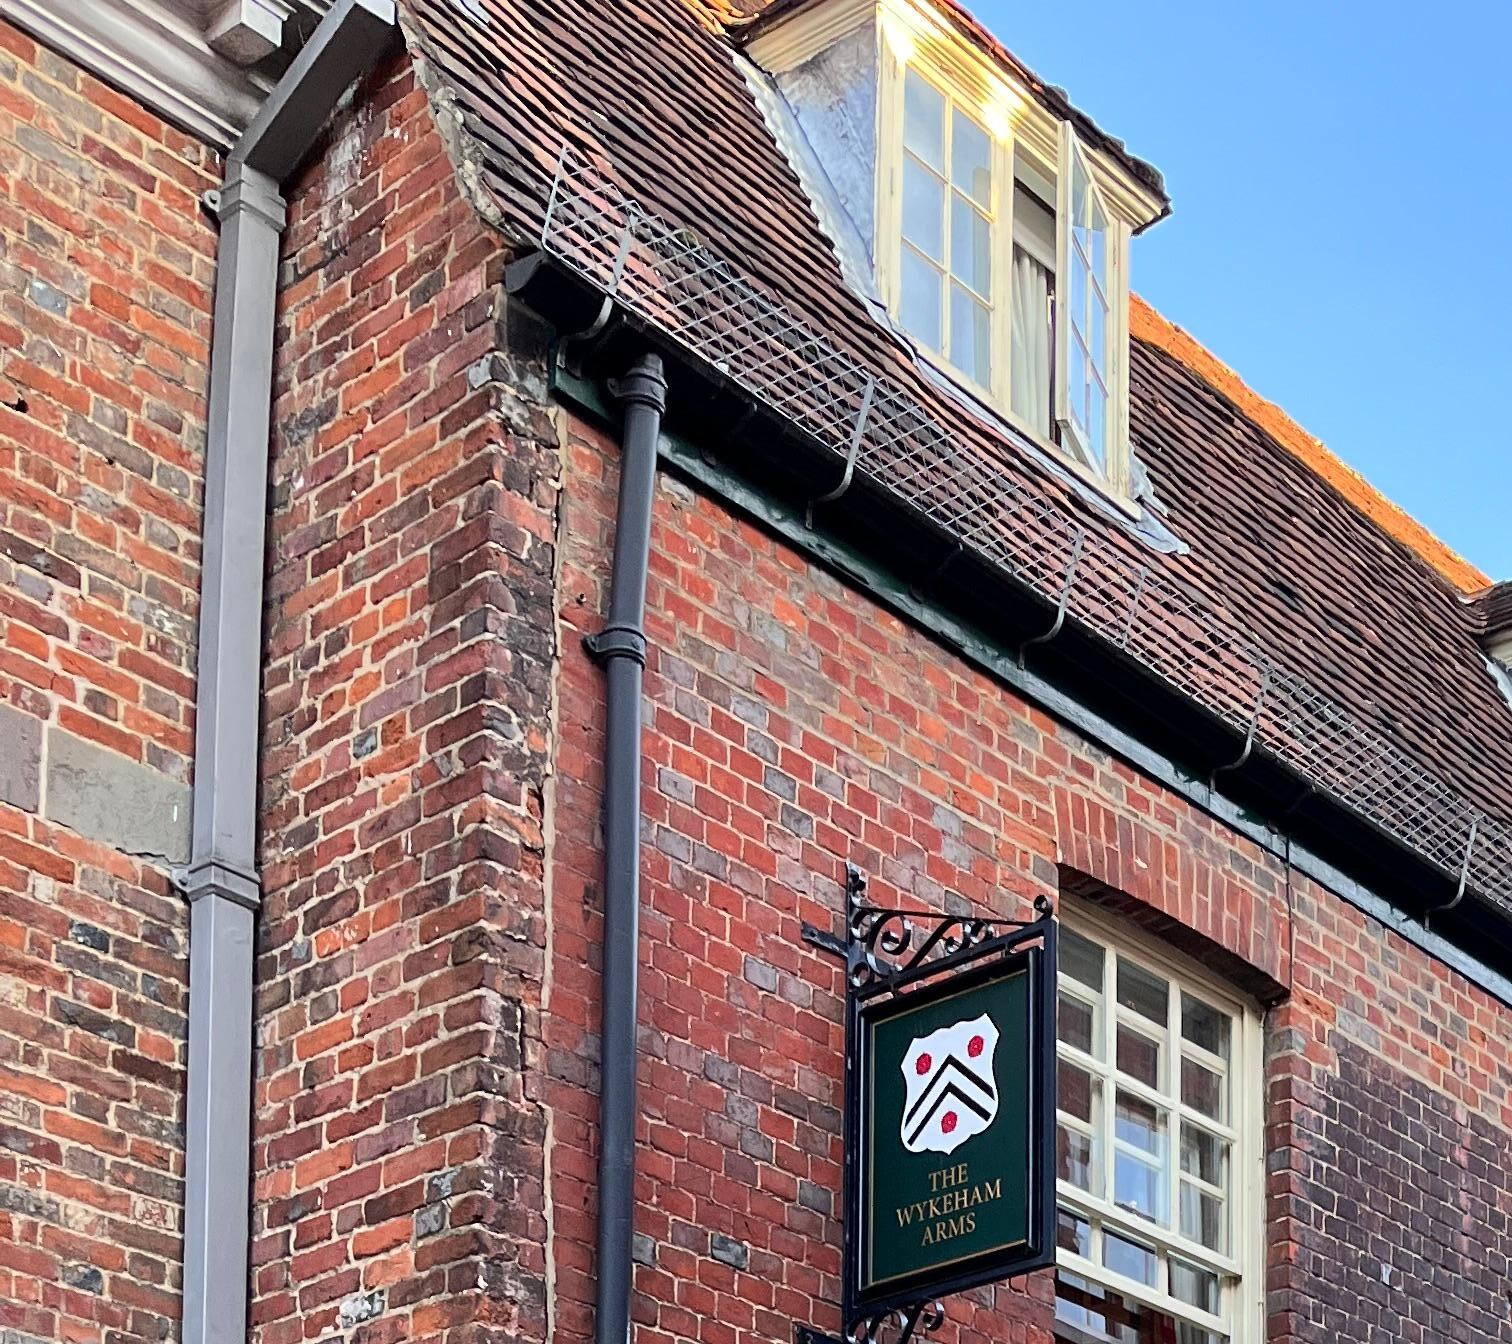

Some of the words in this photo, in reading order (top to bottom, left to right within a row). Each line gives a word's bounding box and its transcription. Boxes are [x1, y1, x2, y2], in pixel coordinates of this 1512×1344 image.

[928, 1163, 969, 1192] THE
[896, 1178, 1002, 1228] WYKEHAM
[921, 1212, 976, 1246] ARMS
